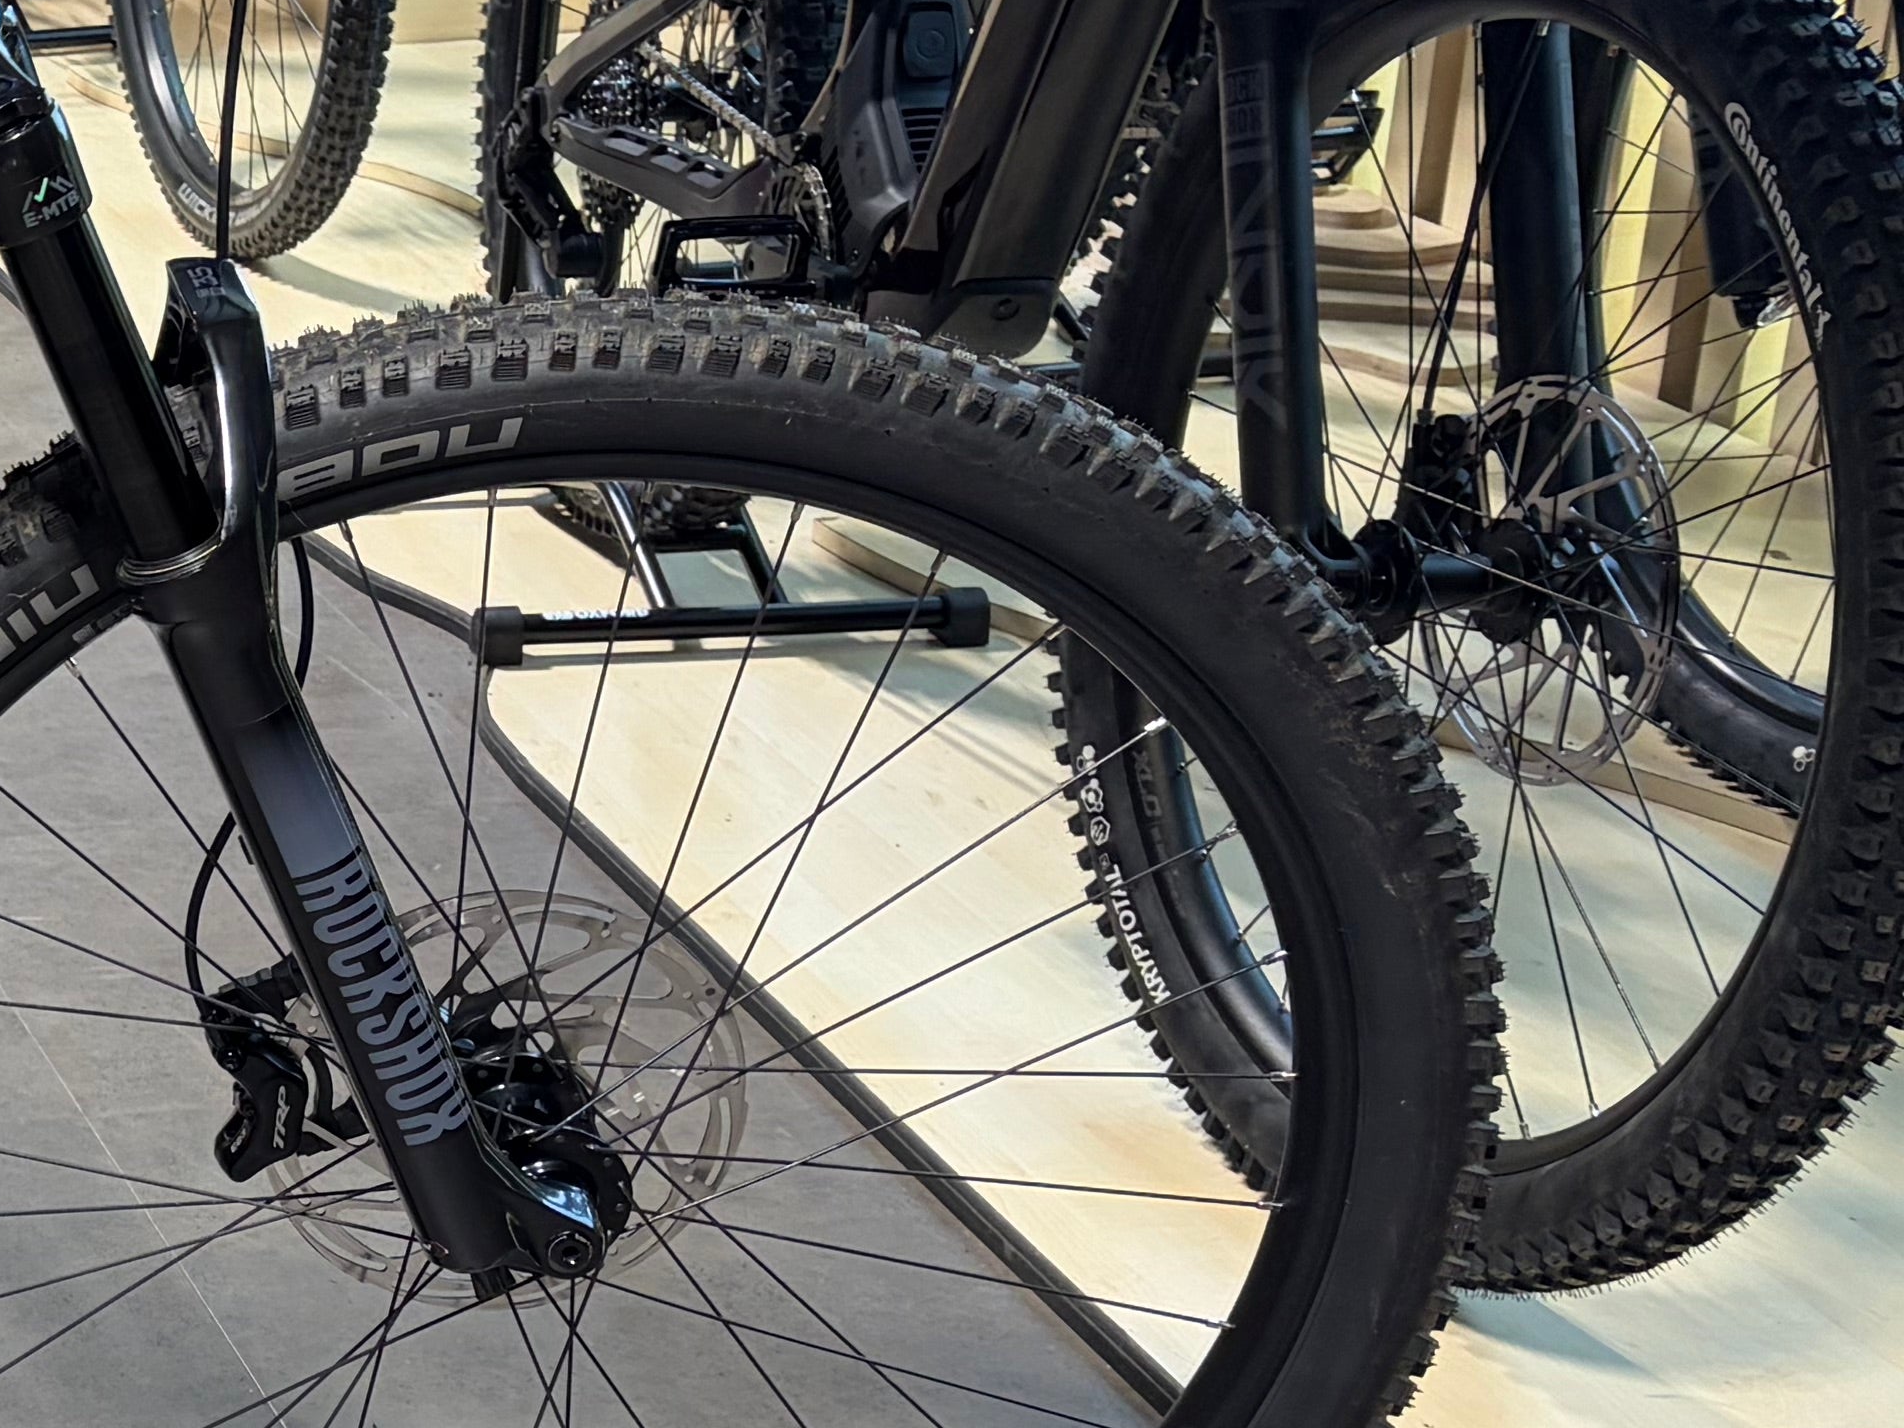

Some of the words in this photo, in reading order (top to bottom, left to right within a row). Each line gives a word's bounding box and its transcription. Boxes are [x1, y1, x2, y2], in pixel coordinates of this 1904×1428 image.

[23, 190, 82, 229] E-MTB
[1723, 100, 1824, 317] Continental
[292, 842, 467, 1145] ROCKSHOX
[269, 1085, 291, 1150] TRP
